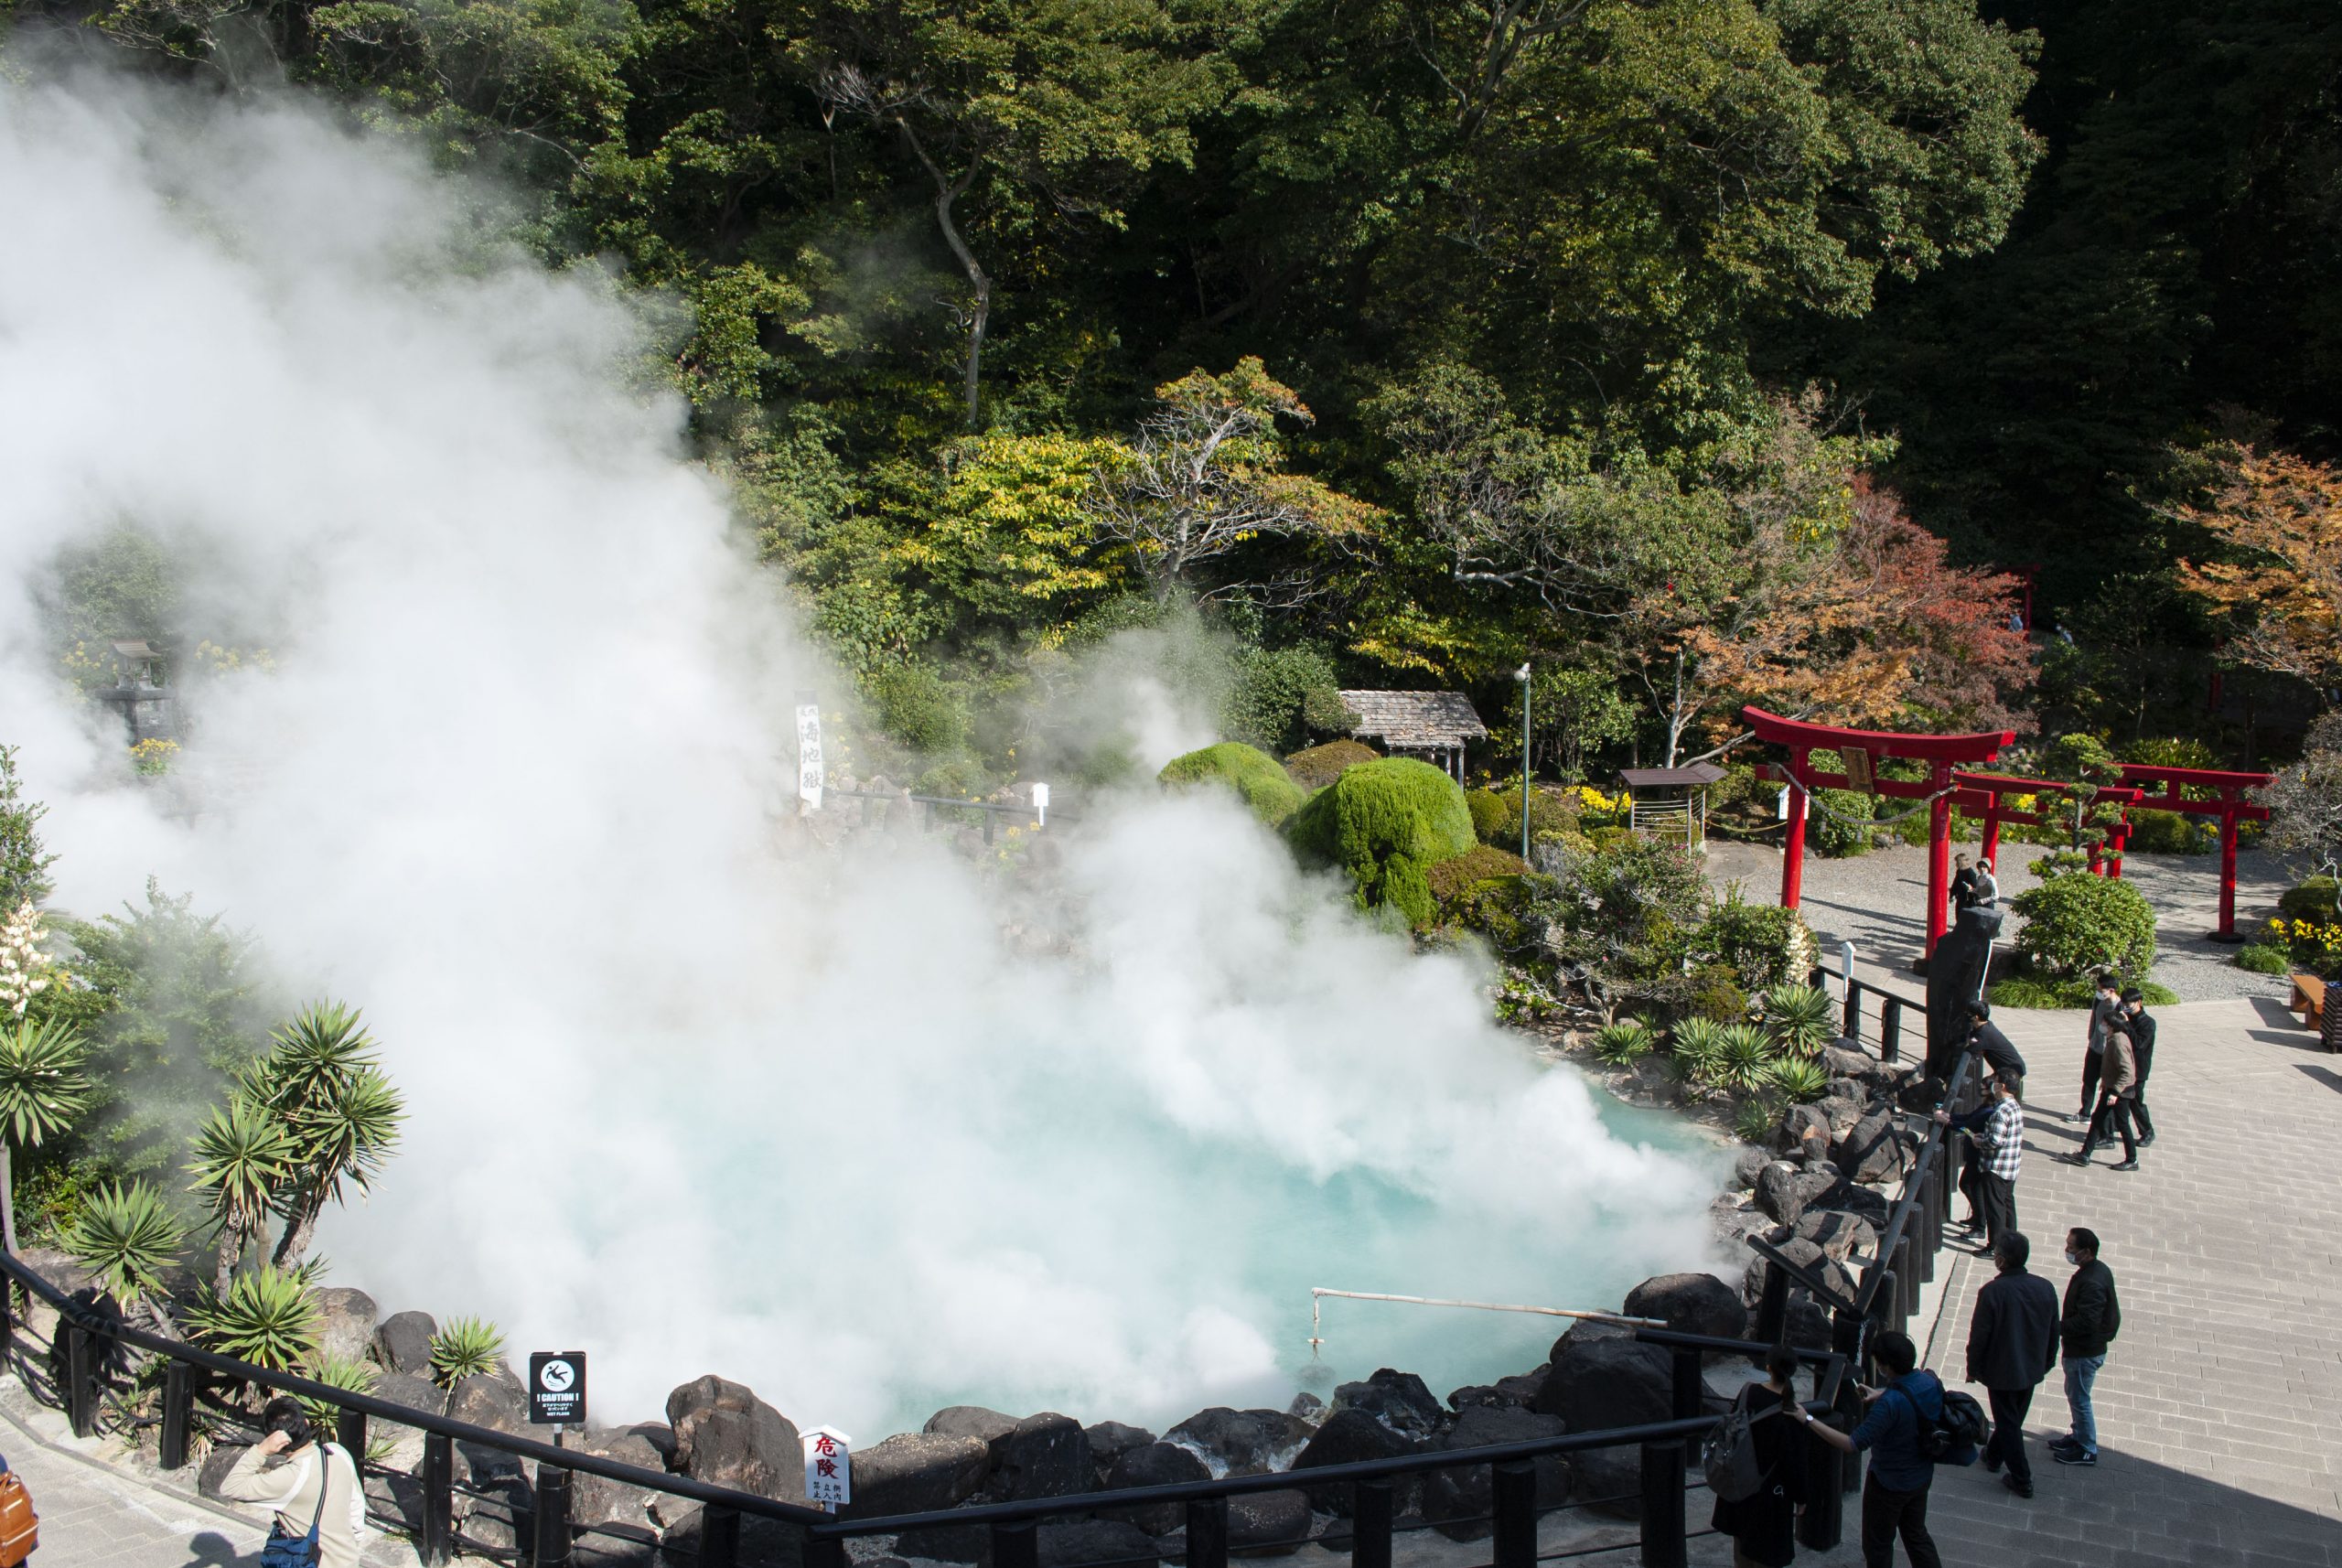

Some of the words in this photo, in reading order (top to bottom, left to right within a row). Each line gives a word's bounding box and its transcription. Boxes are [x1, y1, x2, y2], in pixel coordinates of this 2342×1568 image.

[800, 721, 822, 789] 海地獄
[542, 1392, 575, 1402] CAUTION
[814, 1435, 839, 1479] 危険
[812, 1480, 822, 1499] 禁止
[823, 1483, 833, 1499] 立入
